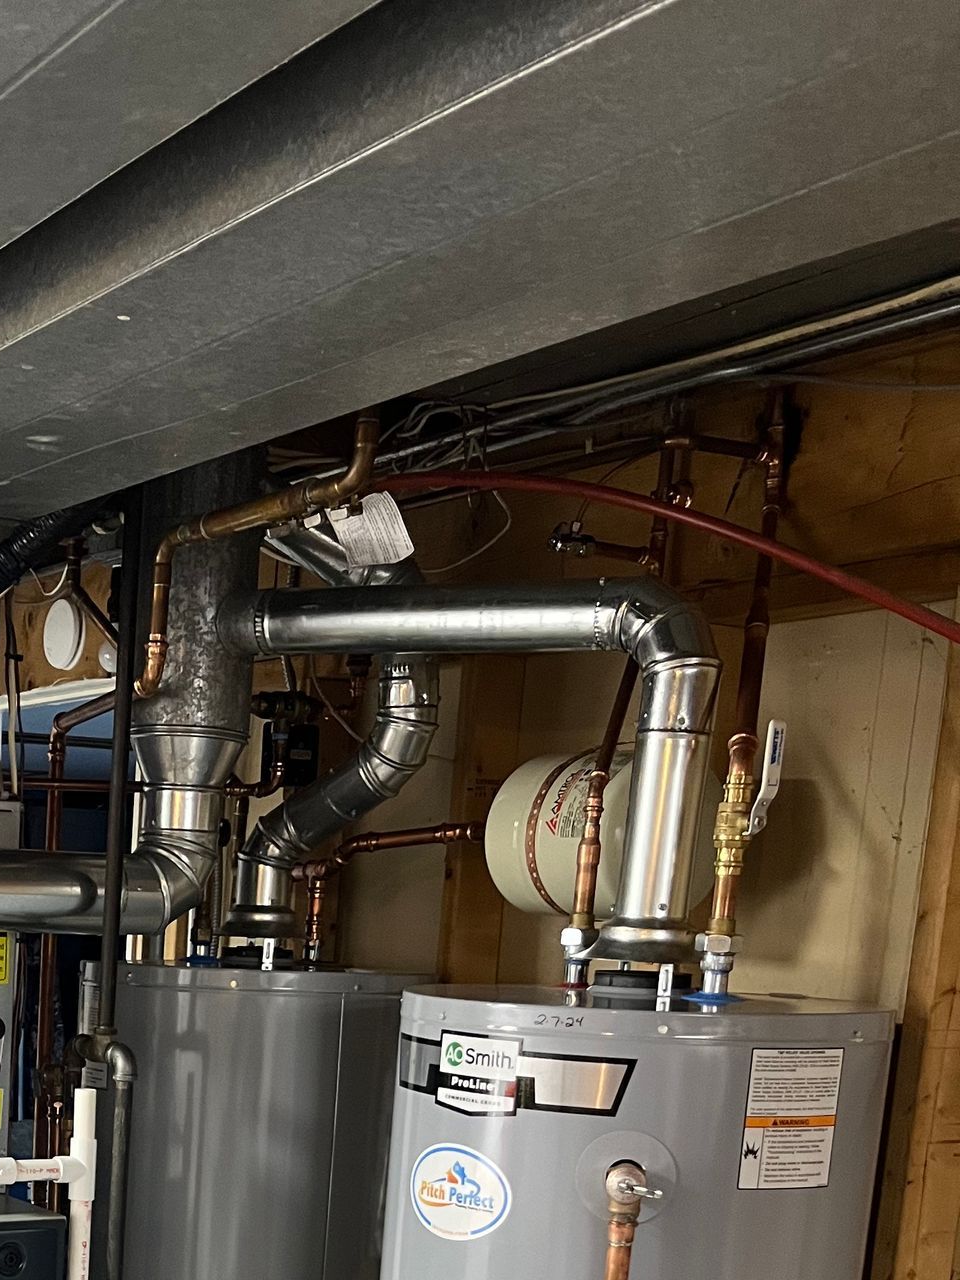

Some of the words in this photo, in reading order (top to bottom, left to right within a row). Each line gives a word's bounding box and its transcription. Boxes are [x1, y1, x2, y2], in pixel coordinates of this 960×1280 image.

[465, 1048, 511, 1069] Smith
[451, 1076, 494, 1092] ProLine
[420, 1180, 445, 1200] Pitch
[449, 1186, 494, 1209] Perfect
